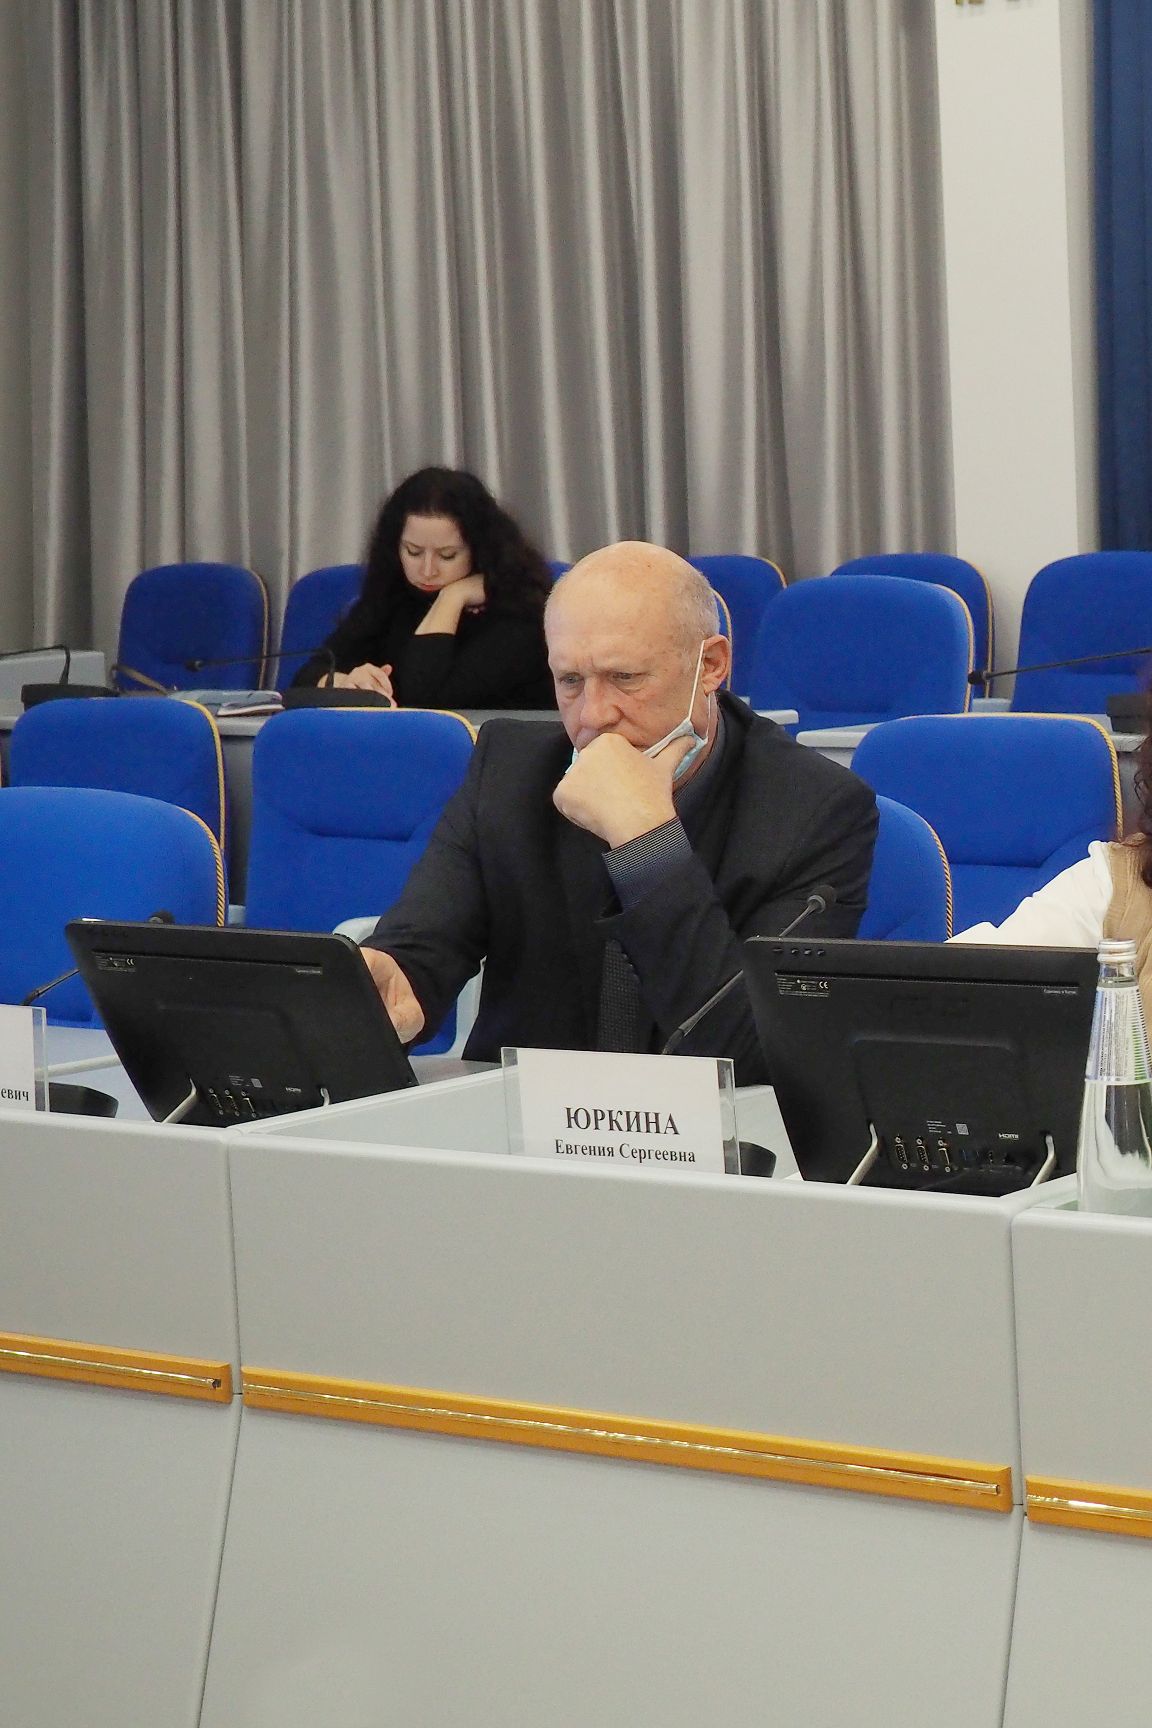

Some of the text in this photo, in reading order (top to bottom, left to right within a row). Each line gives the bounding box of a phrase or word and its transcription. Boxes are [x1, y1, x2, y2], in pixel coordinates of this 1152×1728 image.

[564, 1106, 681, 1136] ЮРКИНА
[554, 1138, 697, 1164] Евгения Сергеевна
